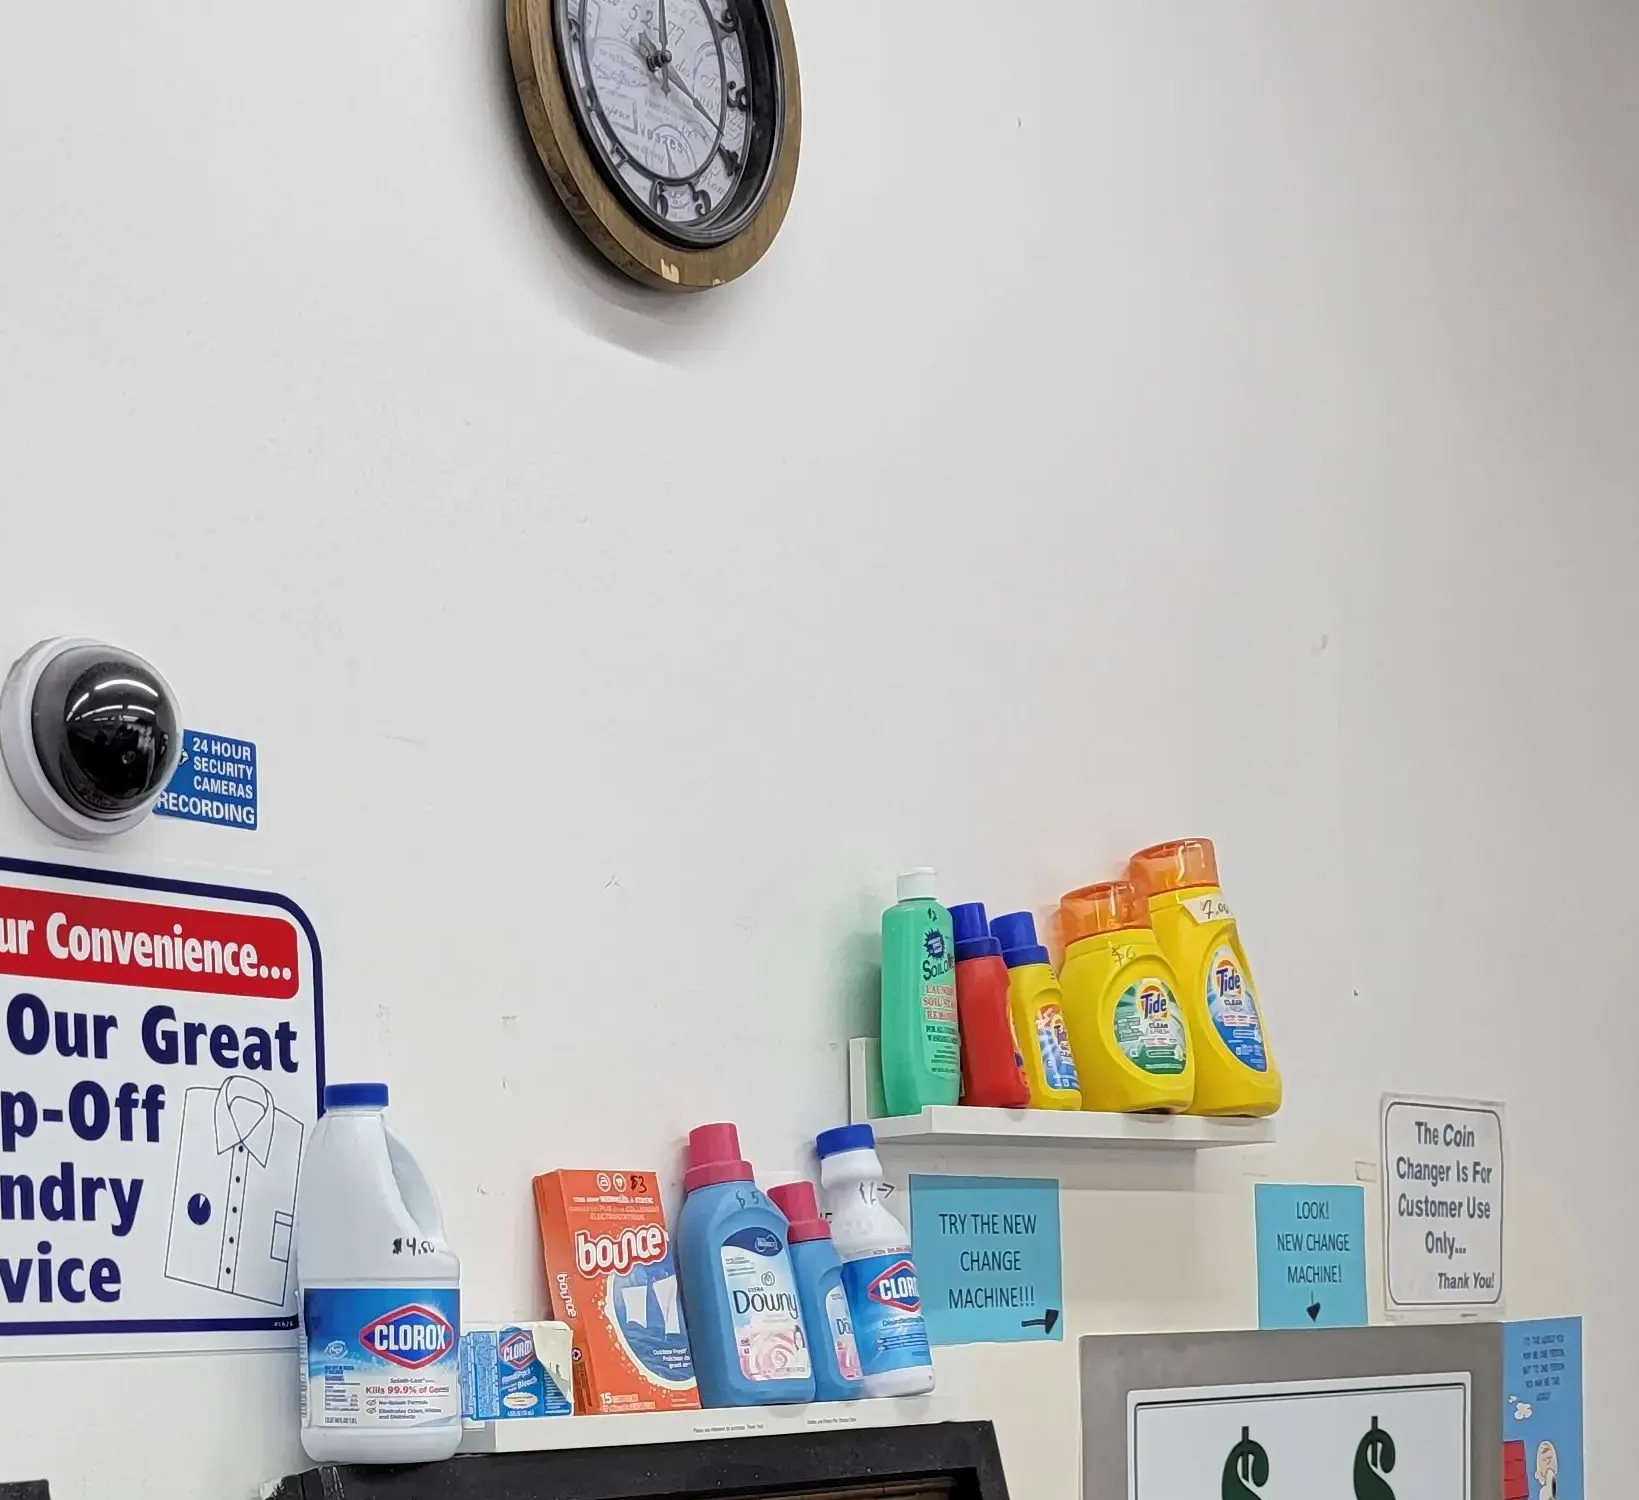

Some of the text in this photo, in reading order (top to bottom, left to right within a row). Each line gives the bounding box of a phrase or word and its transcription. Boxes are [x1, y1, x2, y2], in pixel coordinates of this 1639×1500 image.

[192, 737, 251, 762] 24 HOUR
[192, 755, 253, 780] SECURITY
[193, 775, 253, 799] CAMERAS
[157, 791, 255, 825] RECORDING
[46, 912, 294, 982] Convenience...
[1216, 967, 1241, 997] Tide
[1140, 993, 1167, 1019] Tide
[6, 992, 120, 1060] Our
[141, 1004, 300, 1073] Great
[1414, 1121, 1475, 1147] The Coin
[1396, 1156, 1492, 1187] Changer Is For
[1296, 1201, 1330, 1221] LOOK!
[1398, 1193, 1491, 1219] Customer Use
[939, 1213, 1037, 1236] TRY THE NEW
[577, 1227, 662, 1272] bounce
[1277, 1233, 1351, 1252] NEW CHANGE
[1424, 1230, 1467, 1260] Only...
[960, 1250, 1022, 1273] CHANGE
[1287, 1265, 1343, 1284] MACHINE!
[1437, 1272, 1495, 1290] Thank You!
[556, 1272, 577, 1318] bounce
[732, 1290, 798, 1319] Downy
[948, 1286, 1036, 1309] MACHINE!!!
[374, 1324, 447, 1351] CLOROX
[365, 1385, 427, 1395] Kills 99.9% of
[600, 1392, 613, 1404] 15
